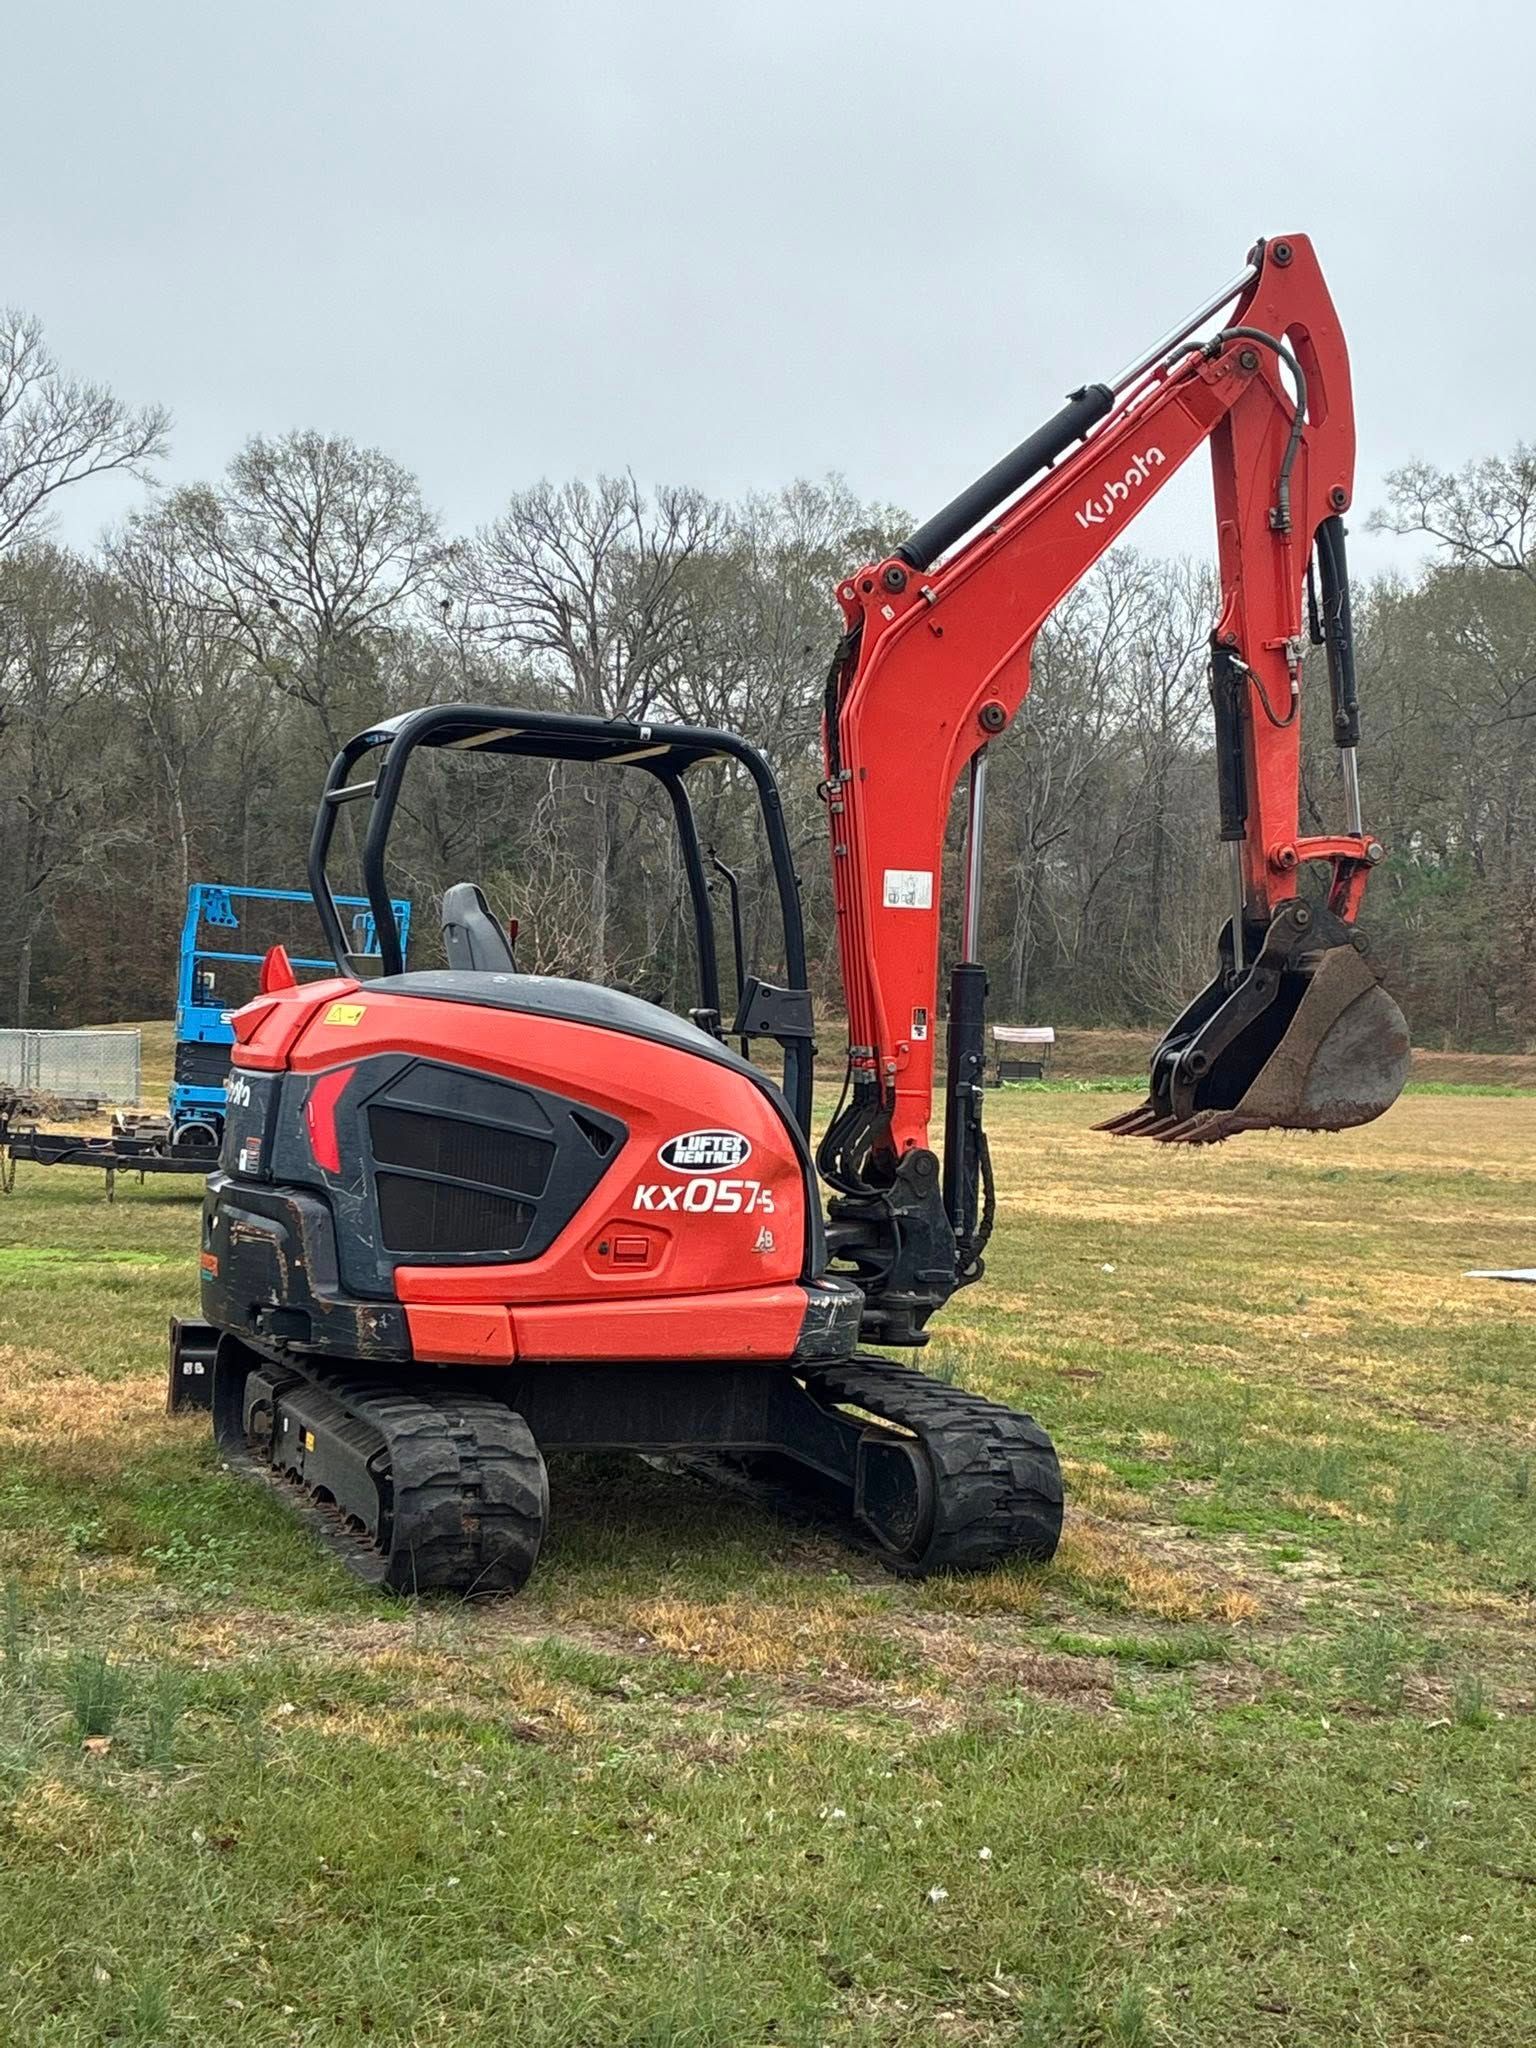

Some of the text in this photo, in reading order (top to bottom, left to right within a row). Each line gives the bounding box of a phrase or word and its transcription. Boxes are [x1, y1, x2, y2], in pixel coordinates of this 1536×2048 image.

[1074, 447, 1166, 529] Kubota
[675, 1136, 742, 1152] LUFTEX
[673, 1151, 741, 1164] RENTALS
